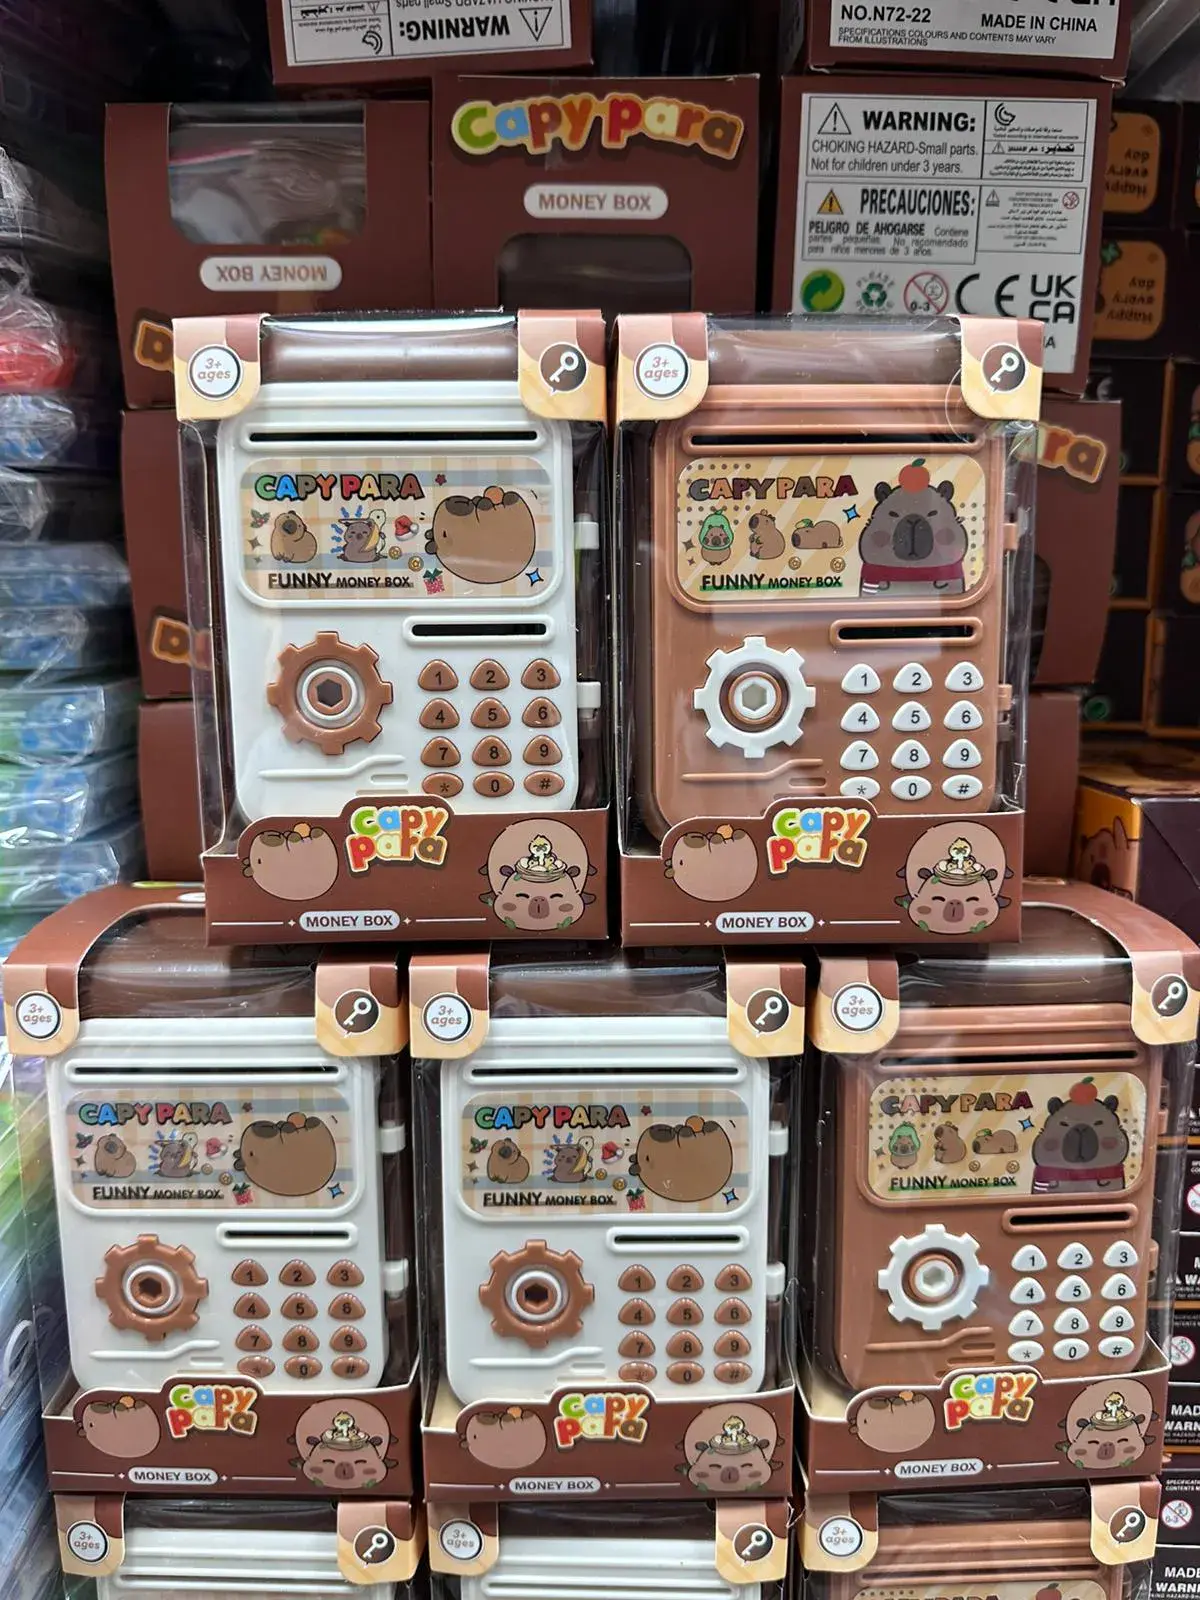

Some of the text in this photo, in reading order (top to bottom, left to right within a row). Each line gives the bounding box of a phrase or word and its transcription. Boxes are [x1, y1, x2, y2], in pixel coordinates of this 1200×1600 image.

[841, 5, 931, 23] NO.N72-22
[399, 15, 510, 41] WARNING:
[981, 13, 1097, 32] MADE IN CHINA
[838, 27, 1056, 44] SPECIFICATIONS COLOURS AND CONTENTS MAY VARY
[838, 36, 928, 46] FROM ILLUSTRATIONS
[863, 110, 976, 132] WARNING:
[812, 139, 978, 158] CHOKING HAZARD-Small parts.
[1124, 149, 1150, 164] day
[811, 158, 963, 176] Not for children under 3 years.
[538, 193, 651, 211] MONEY BOX
[859, 188, 976, 216] PRECAUCIONES:
[808, 221, 969, 237] PELIGRO DE AHOGARSE Contiene
[911, 238, 969, 248] recomendado
[217, 265, 328, 282] MONEY BOX
[1030, 274, 1078, 299] UK
[1129, 276, 1155, 290] day
[910, 300, 930, 312] 0-3
[1029, 301, 1075, 323] CA
[205, 358, 222, 369] 3+
[652, 356, 669, 368] 3+
[198, 368, 231, 383] ages
[644, 368, 678, 382] ages
[255, 473, 425, 501] CAPY PARA
[688, 474, 858, 501] CAPY PARA
[268, 573, 410, 588] FUNNY MONEY BOX
[702, 573, 842, 590] FUNNY MONEY BOX
[435, 668, 546, 685] 1 2 3
[861, 672, 972, 686] 1 2 3
[435, 706, 547, 723] 4 5 6
[858, 710, 971, 725] 4 5 6
[439, 744, 549, 760] 7 8 9
[859, 748, 969, 762] 7 8 9
[491, 779, 499, 793] 0
[909, 783, 917, 796] 0
[305, 914, 393, 928] MONEY BOX
[722, 916, 807, 929] MONEY BOX
[849, 995, 864, 1006] 3+
[29, 1003, 43, 1014] 3+
[438, 1005, 454, 1015] 3+
[842, 1006, 873, 1018] ages
[23, 1012, 52, 1025] ages
[431, 1015, 462, 1028] ages
[880, 1091, 1033, 1116] CAPY PARA
[79, 1102, 233, 1126] CAPY PARA
[474, 1105, 630, 1130] CAPY PARA
[890, 1176, 1016, 1190] FUNNY MONEY BOX
[93, 1186, 221, 1199] FUNNY MONEY BOX
[483, 1192, 614, 1207] FUNNY MONEY BOX
[1075, 1253, 1083, 1265] 2
[1120, 1251, 1128, 1263] 3
[1026, 1284, 1126, 1299] 4 5 6
[1026, 1316, 1124, 1331] 7 8 9
[1068, 1347, 1077, 1358] 0
[900, 1463, 977, 1475] MONEY BOX
[133, 1471, 212, 1482] MONEY BOX
[515, 1481, 594, 1490] MONEY BOX
[74, 1540, 100, 1551] ages
[446, 1538, 474, 1549] ages
[825, 1535, 854, 1546] ages
